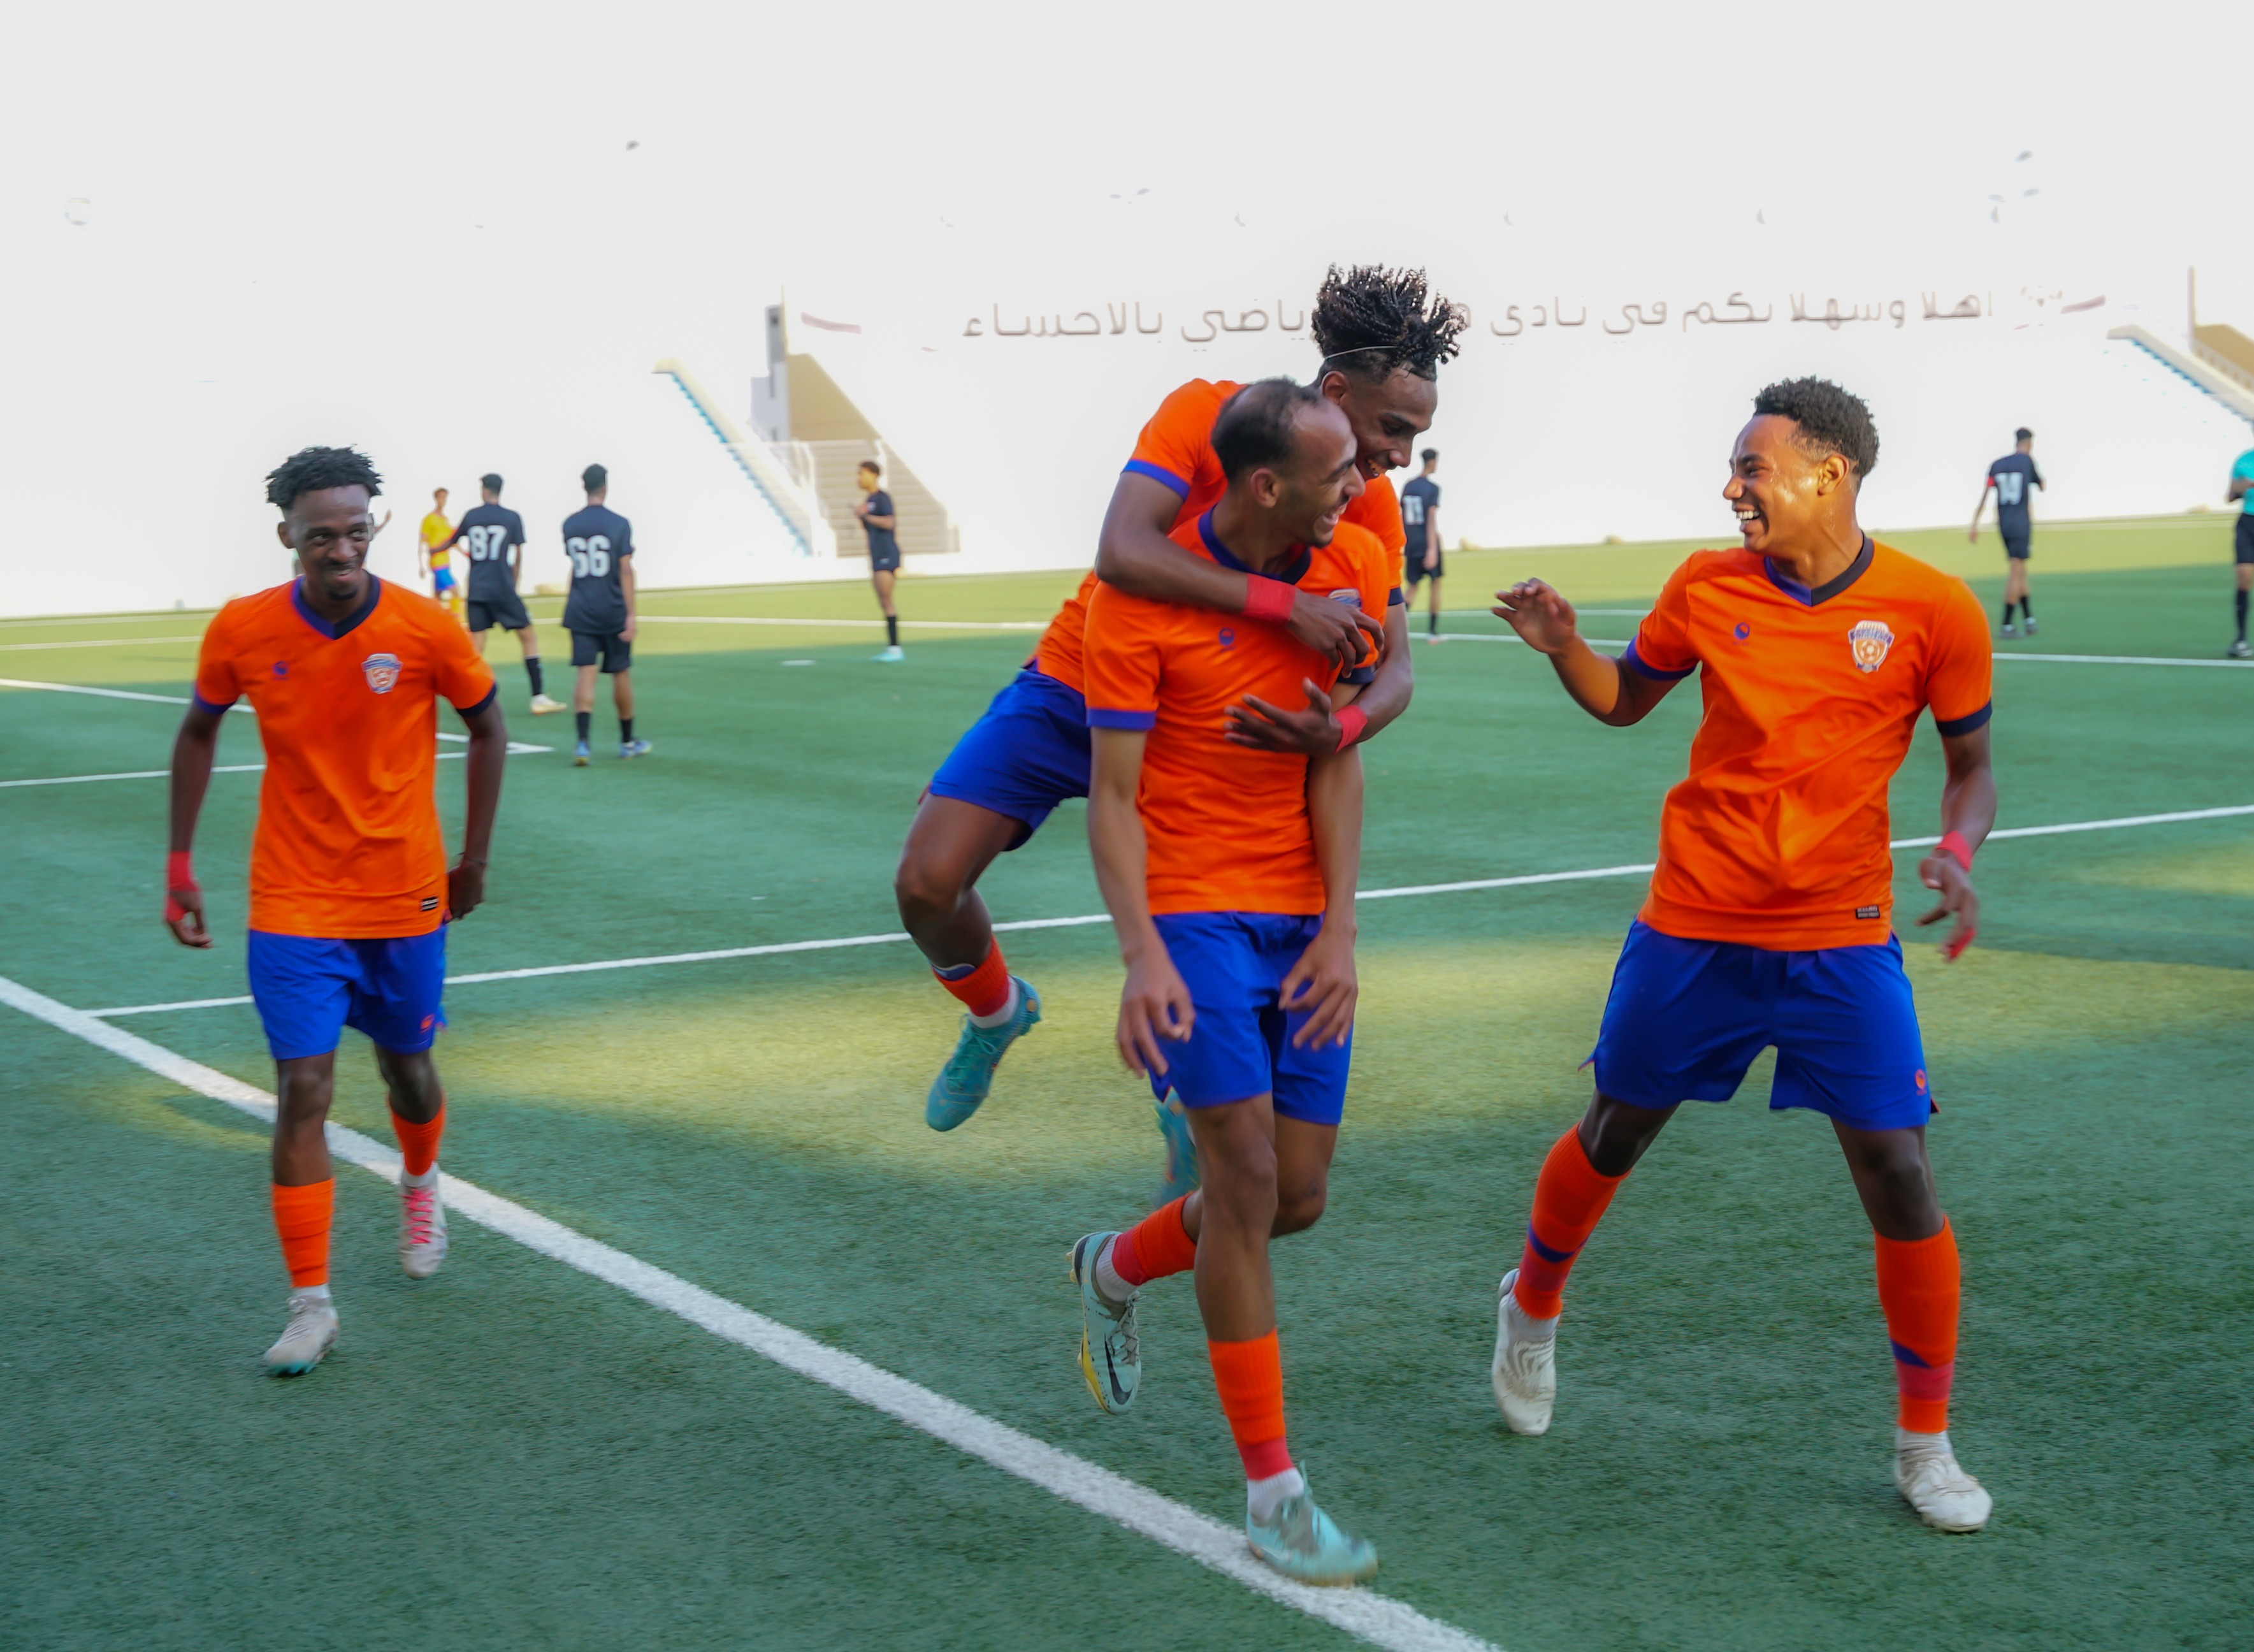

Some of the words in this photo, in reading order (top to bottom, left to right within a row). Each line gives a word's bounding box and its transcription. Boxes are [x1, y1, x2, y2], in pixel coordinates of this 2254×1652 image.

[1180, 298, 1305, 352] ياضي
[1490, 295, 1587, 346] نادي
[1602, 291, 1668, 344] في
[1789, 293, 1906, 331] وسهلا
[468, 525, 507, 561] 87
[568, 535, 610, 578] 66
